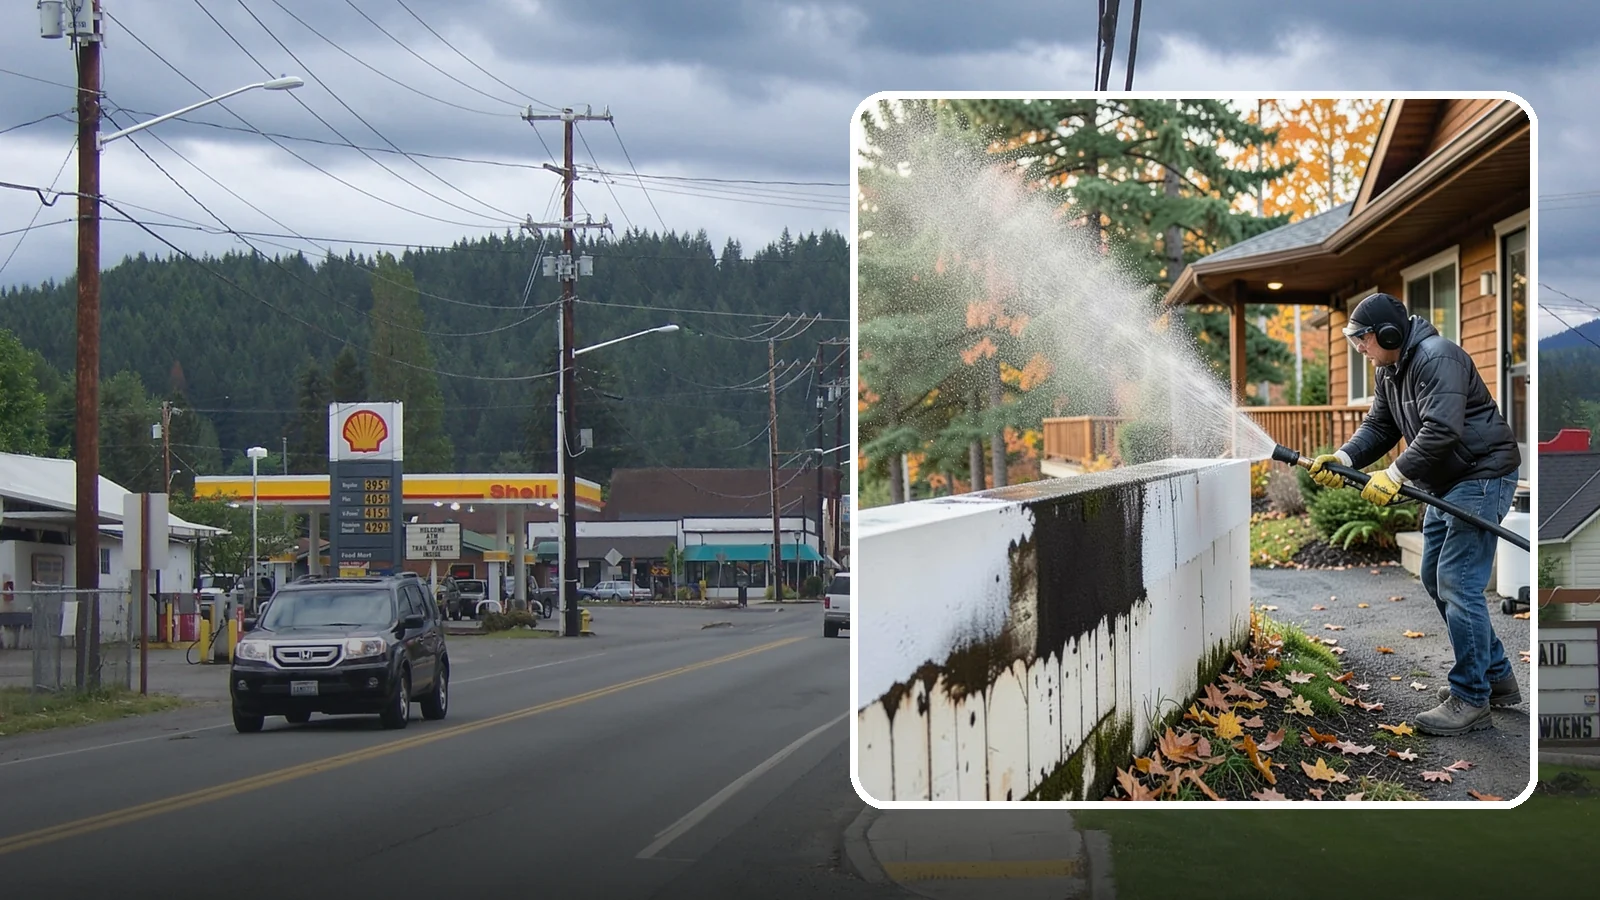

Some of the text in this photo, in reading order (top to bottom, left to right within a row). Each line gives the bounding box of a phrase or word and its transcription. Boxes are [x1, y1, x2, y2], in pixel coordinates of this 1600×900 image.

[366, 480, 383, 490] 395
[489, 484, 547, 499] Shell
[366, 494, 383, 504] 405
[366, 508, 383, 518] 415
[366, 522, 383, 533] 429
[1538, 642, 1567, 666] AID
